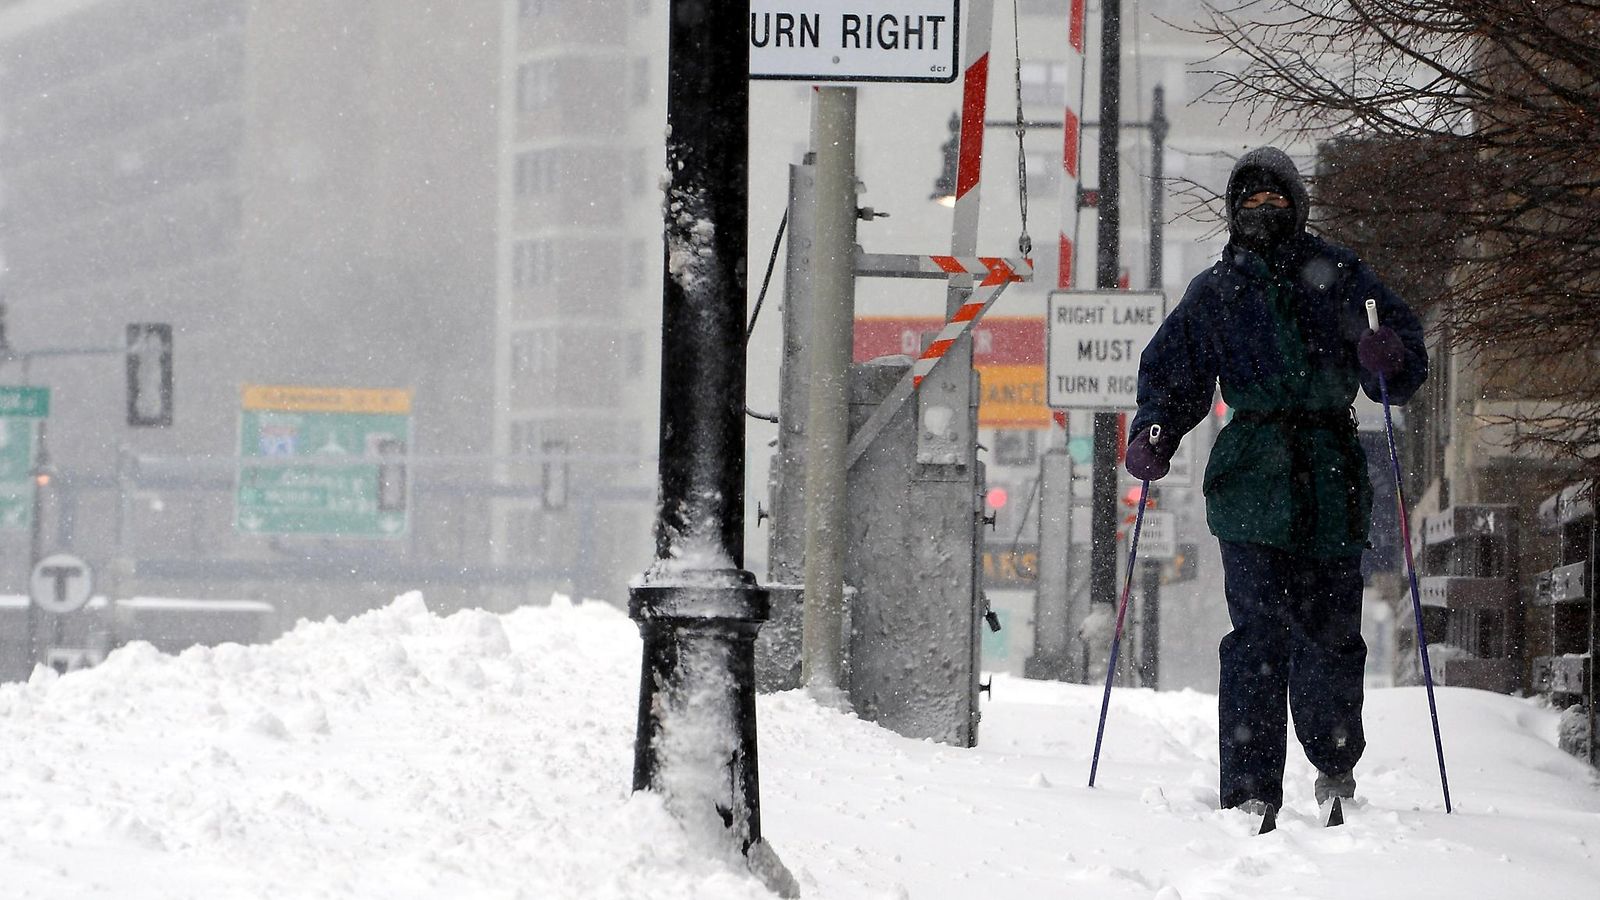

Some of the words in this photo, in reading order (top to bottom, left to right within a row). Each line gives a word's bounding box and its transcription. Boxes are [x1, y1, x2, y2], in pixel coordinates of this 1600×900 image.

[842, 14, 946, 50] RIGHT
[930, 65, 946, 73] dcr
[1057, 306, 1105, 324] RIGHT
[1113, 306, 1155, 325] LANE
[1078, 339, 1134, 361] MUST
[1057, 375, 1099, 393] TURN
[40, 566, 82, 601] T
